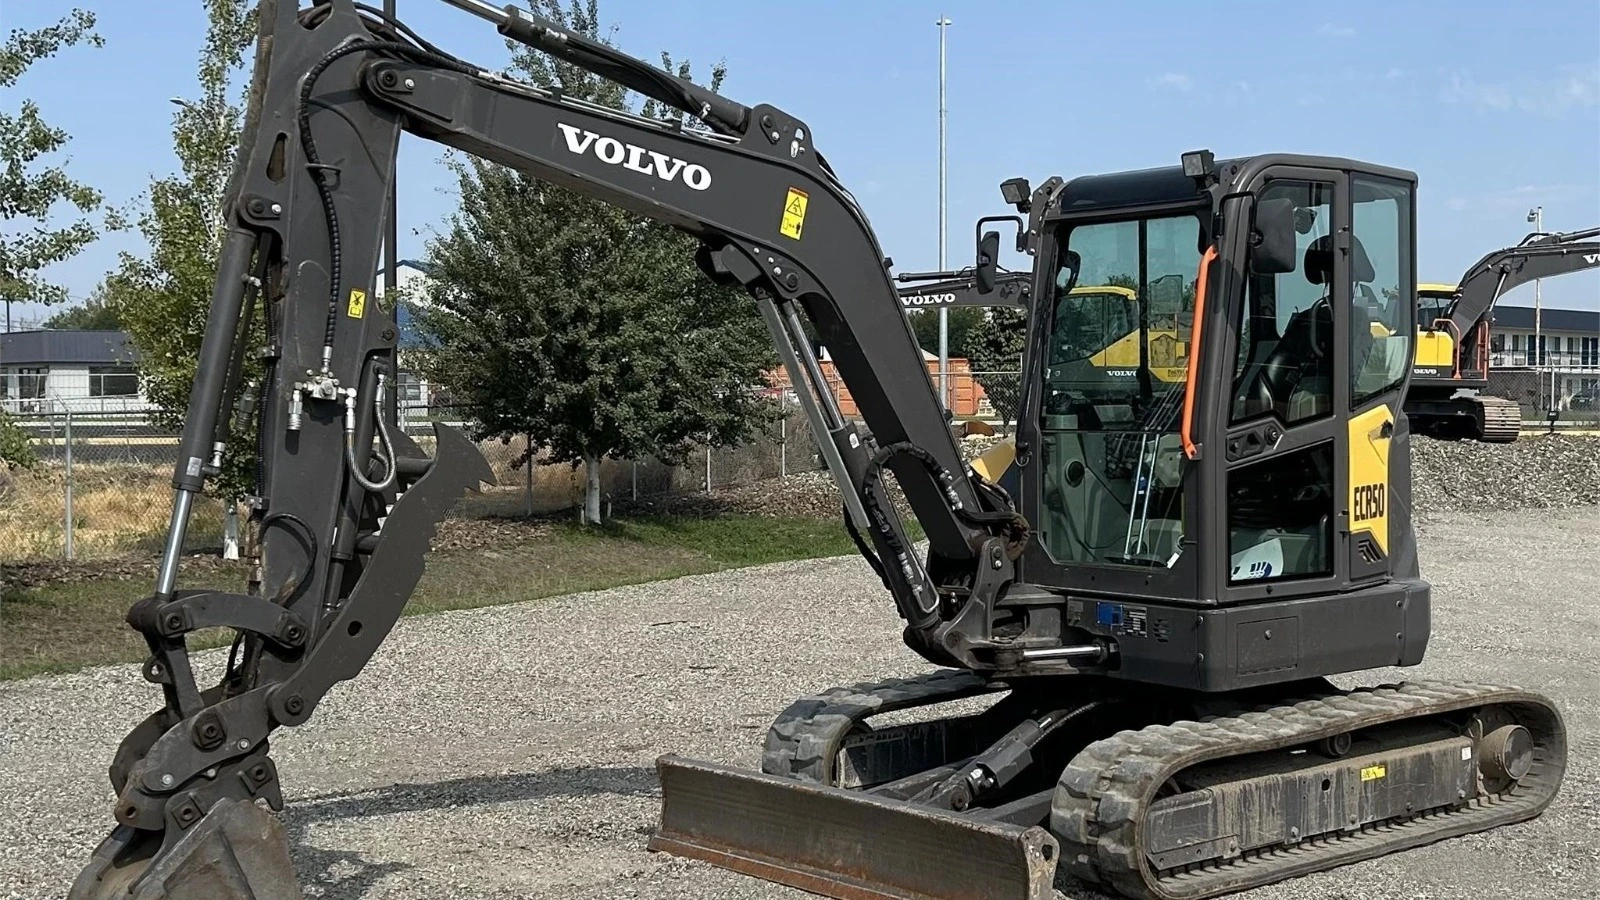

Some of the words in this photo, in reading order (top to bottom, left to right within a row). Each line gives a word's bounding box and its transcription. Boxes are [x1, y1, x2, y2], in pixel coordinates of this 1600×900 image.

[557, 123, 712, 191] VOLVO
[900, 293, 956, 306] VOLVO
[1354, 483, 1385, 522] ECR50
